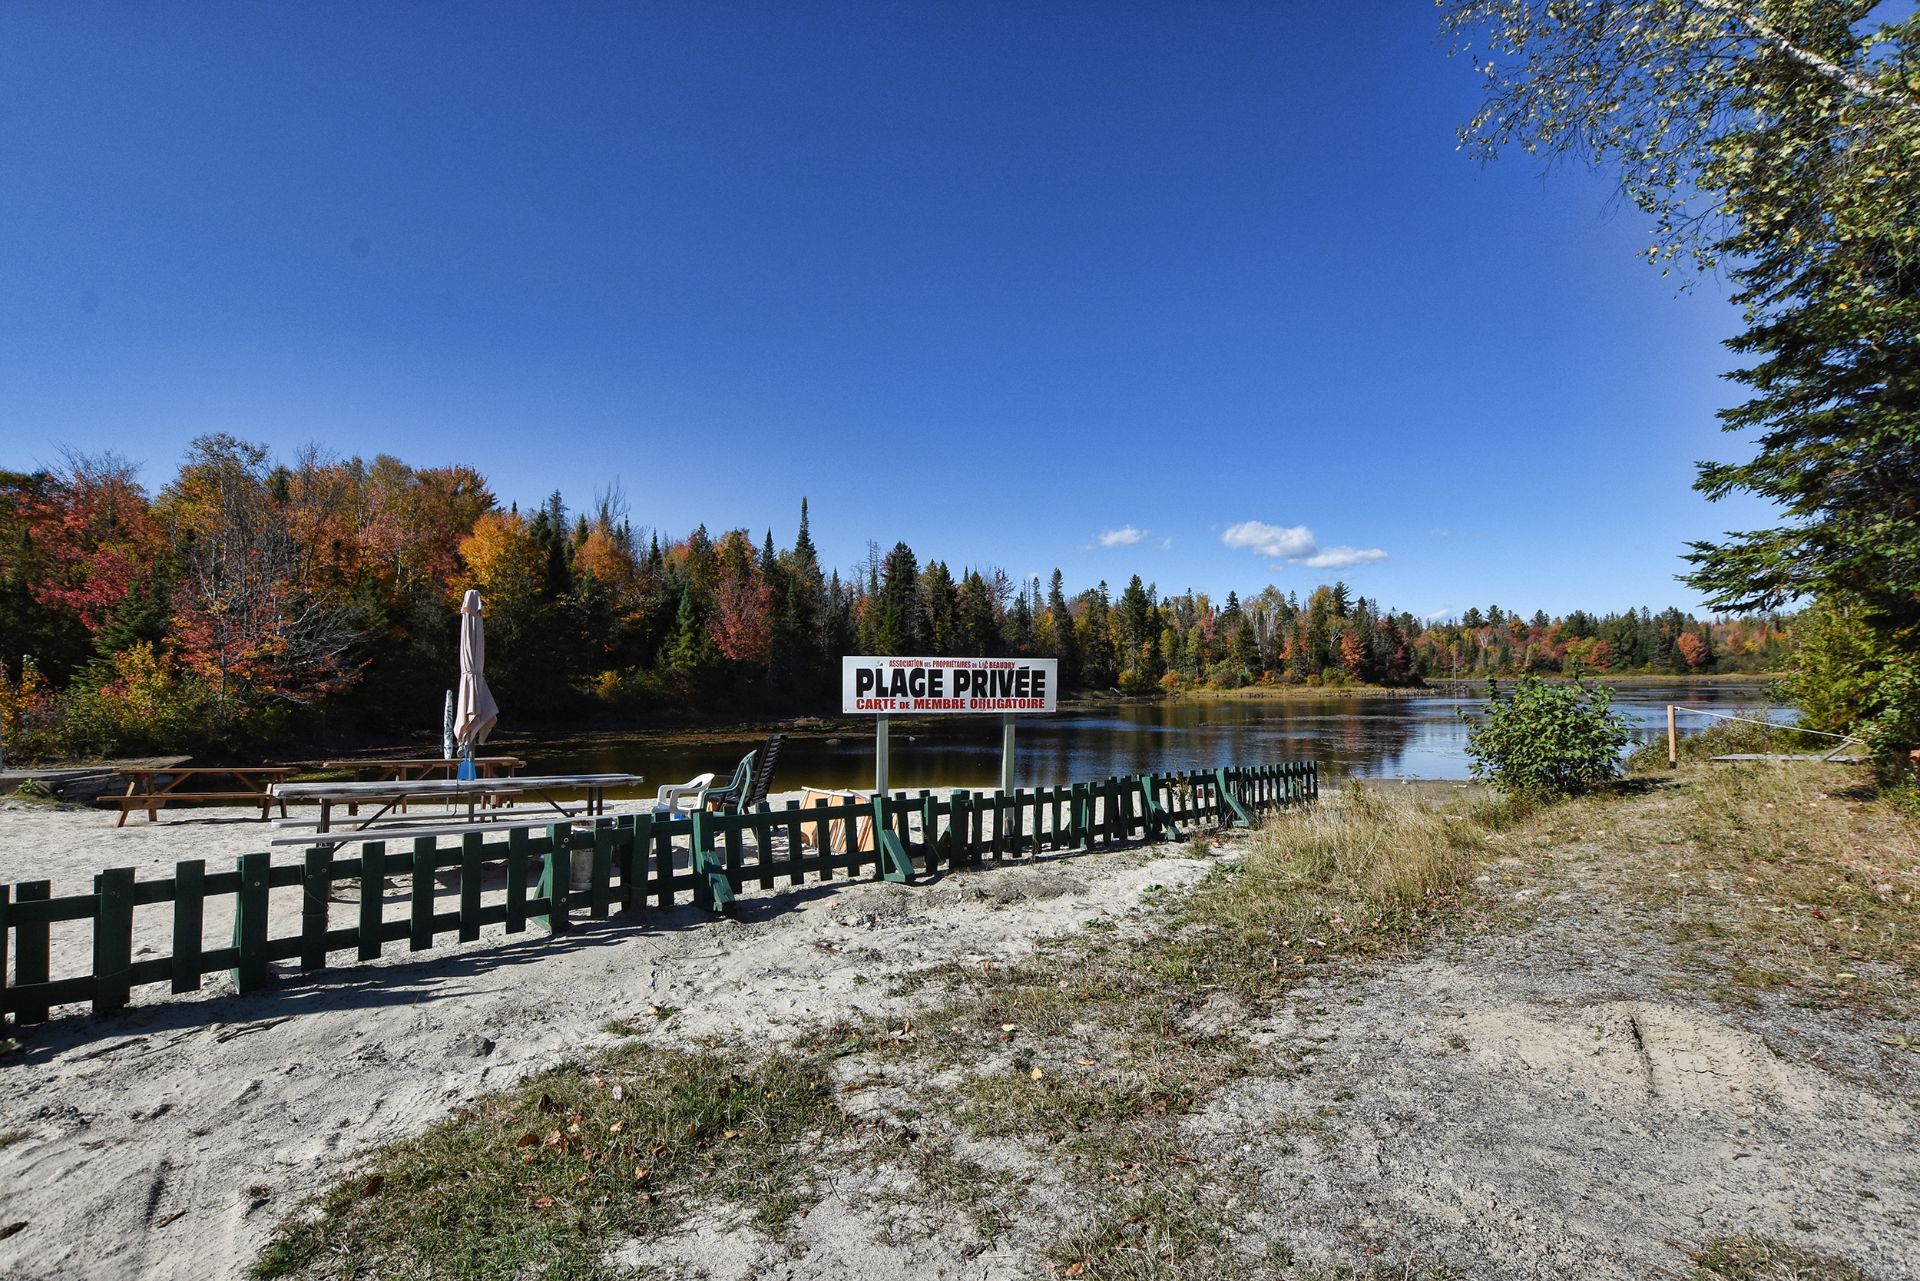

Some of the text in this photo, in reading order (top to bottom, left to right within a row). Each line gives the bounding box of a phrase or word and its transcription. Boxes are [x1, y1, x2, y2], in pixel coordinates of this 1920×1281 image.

[888, 659, 924, 668] ASSOCIATION
[856, 666, 1046, 698] PLAGE PRIVÉE
[856, 698, 1045, 710] CARTE DE MEMBRE OBLIGATOIRE
